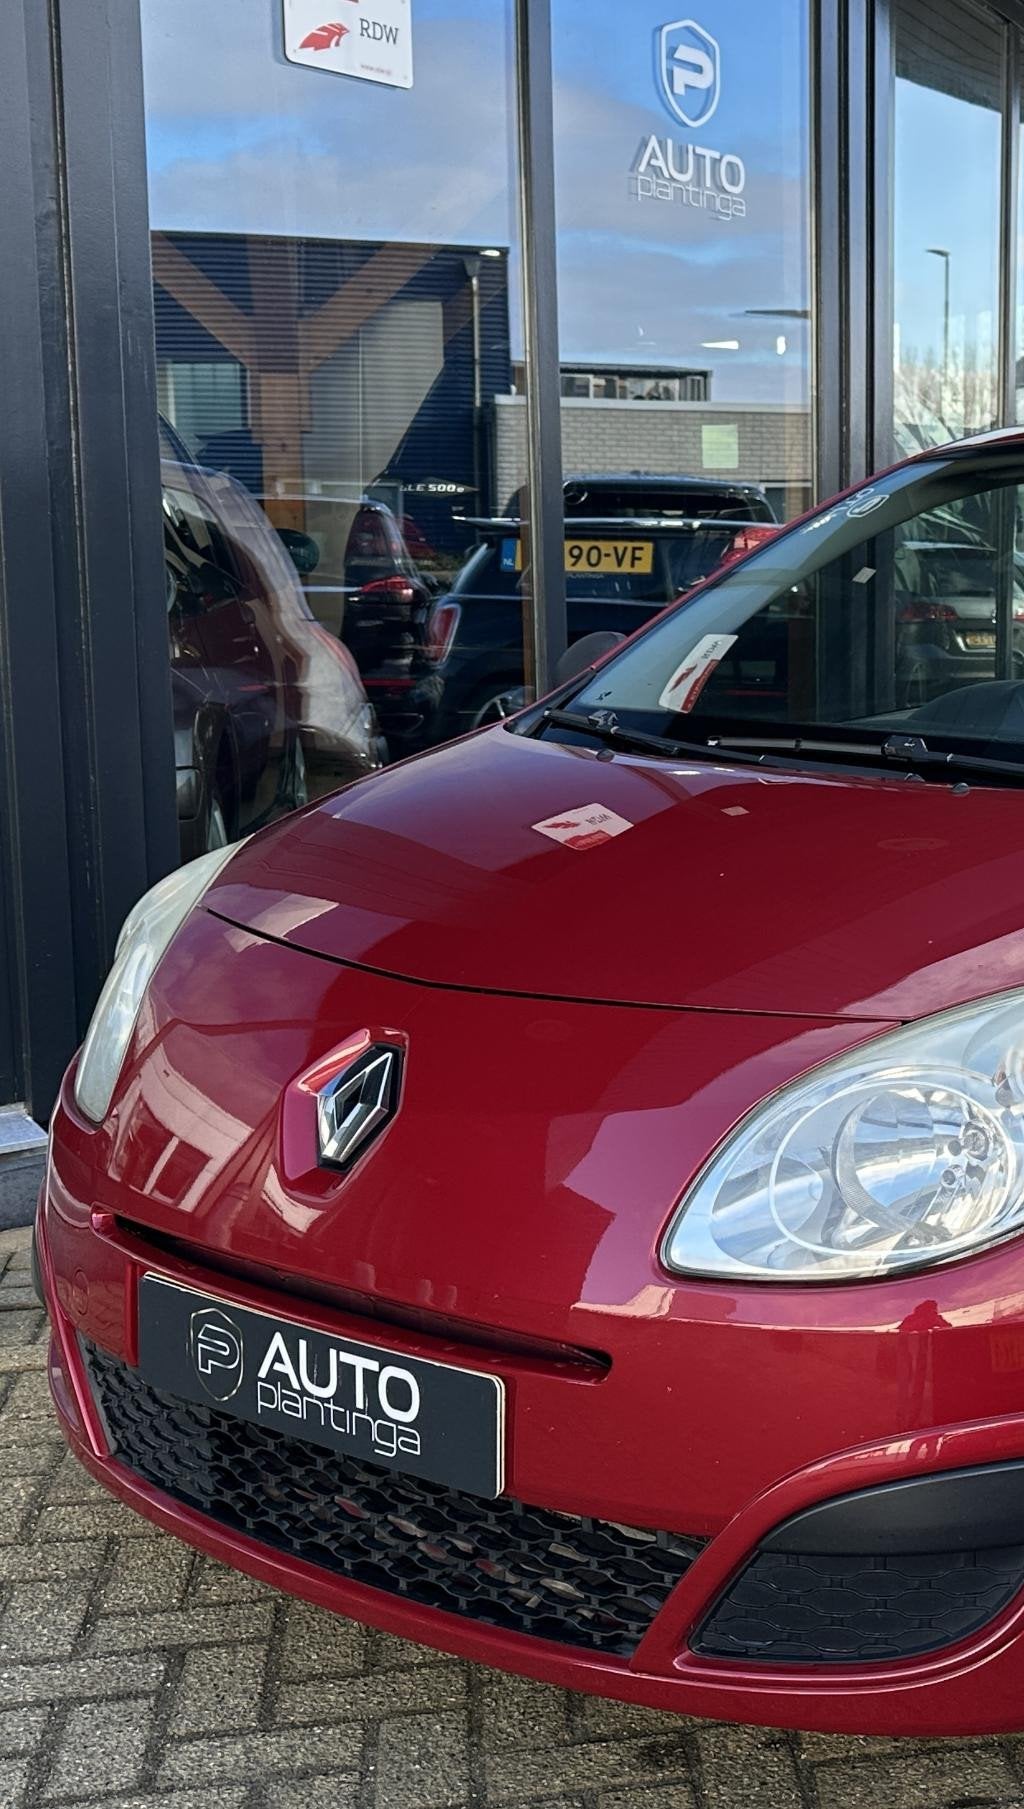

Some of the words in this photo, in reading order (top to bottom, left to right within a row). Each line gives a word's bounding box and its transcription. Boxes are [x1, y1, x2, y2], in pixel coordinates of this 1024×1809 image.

[359, 17, 399, 45] RDW
[638, 134, 746, 194] AUTO
[637, 174, 746, 221] plantinga
[502, 558, 514, 566] NL
[568, 545, 644, 568] 90-VF
[257, 1331, 421, 1423] AUTO
[257, 1381, 421, 1458] plantinga
